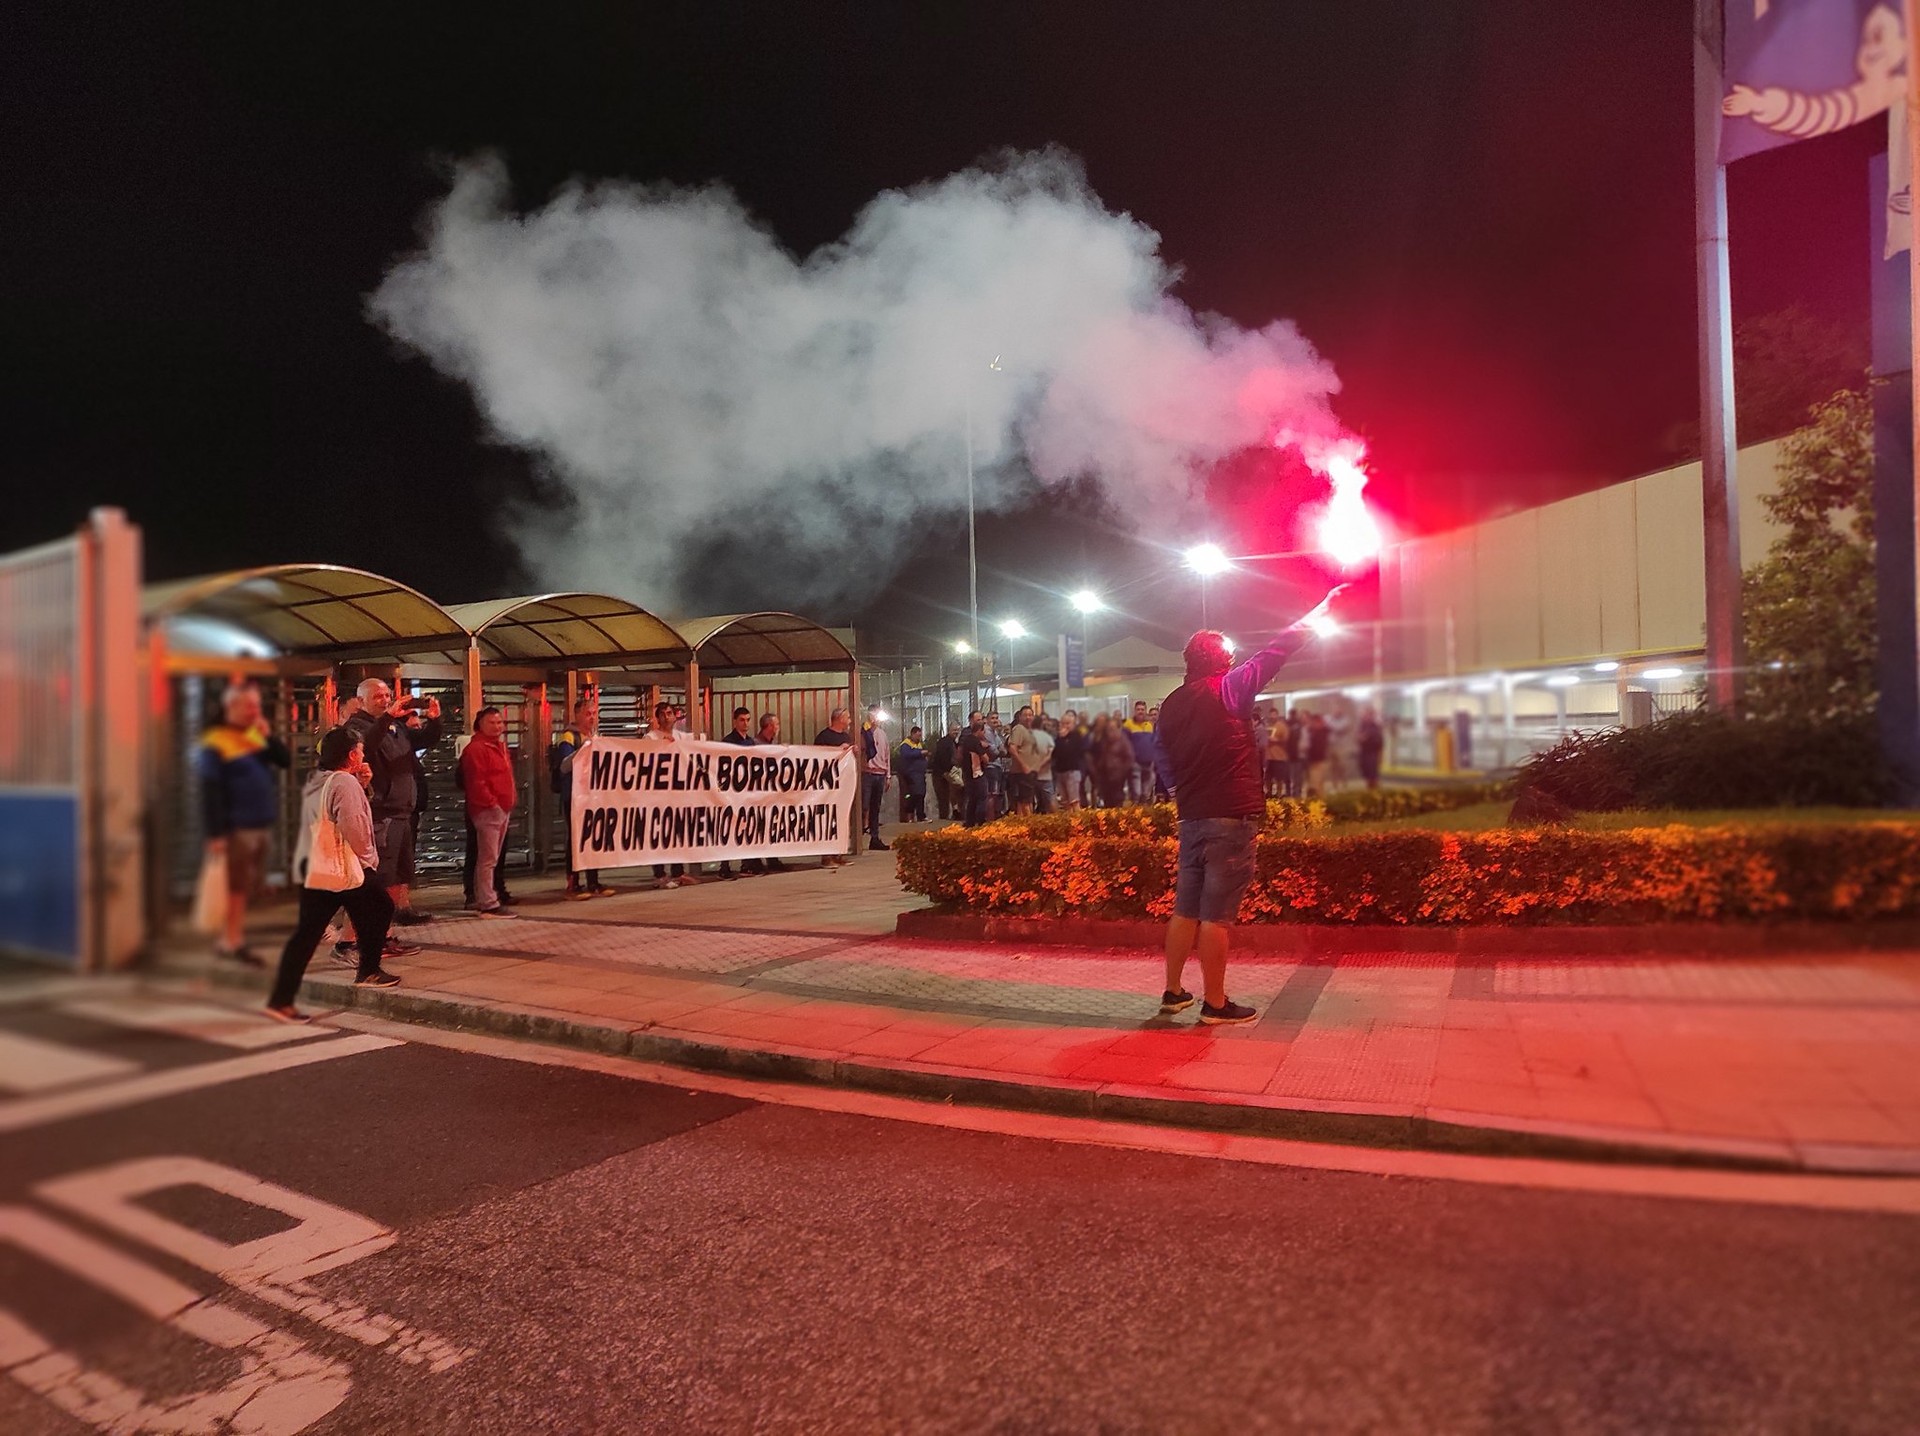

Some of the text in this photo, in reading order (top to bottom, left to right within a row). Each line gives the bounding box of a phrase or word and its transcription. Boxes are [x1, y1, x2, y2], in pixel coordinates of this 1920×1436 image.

[590, 751, 840, 793] MICHELIN BORROKAN!
[579, 803, 838, 853] POR UN CONVENIO CON GARANTIA
